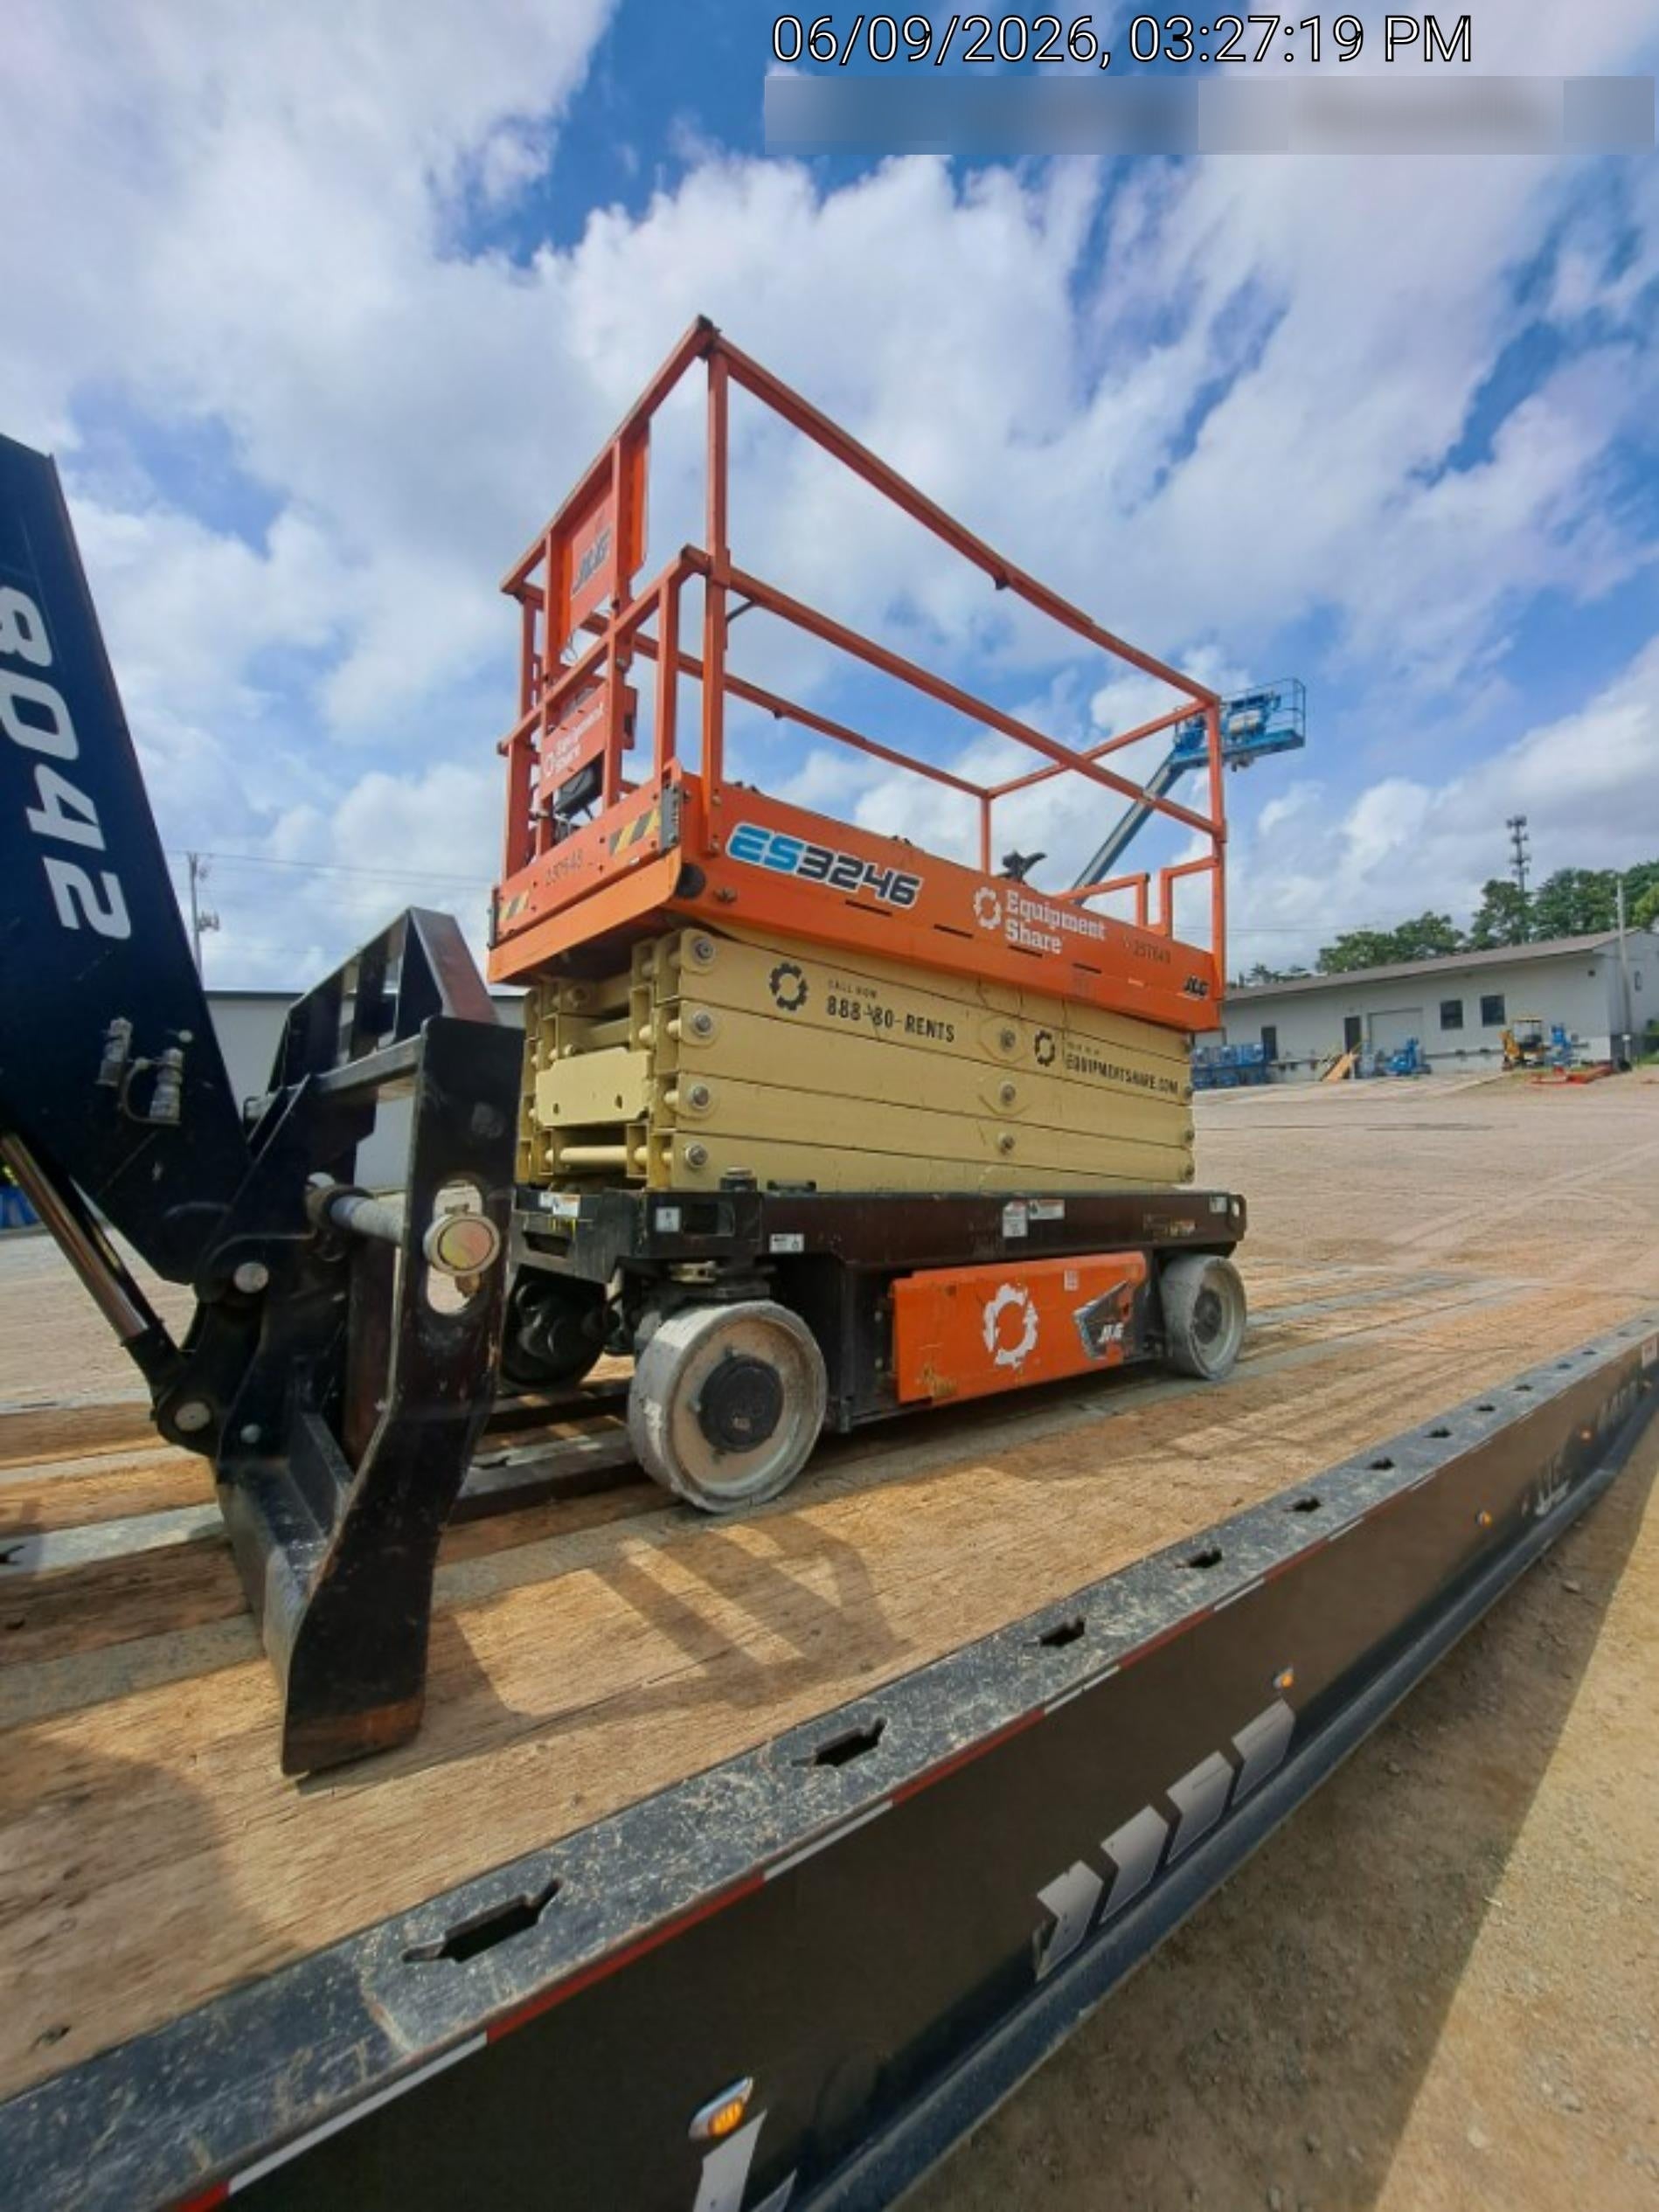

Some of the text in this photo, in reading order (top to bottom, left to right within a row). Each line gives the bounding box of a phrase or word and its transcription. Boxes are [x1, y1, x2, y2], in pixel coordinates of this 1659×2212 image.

[0, 586, 131, 940] 8042
[727, 823, 922, 908] ES3246
[1004, 918, 1062, 955] Share
[1005, 889, 1106, 941] Equipment
